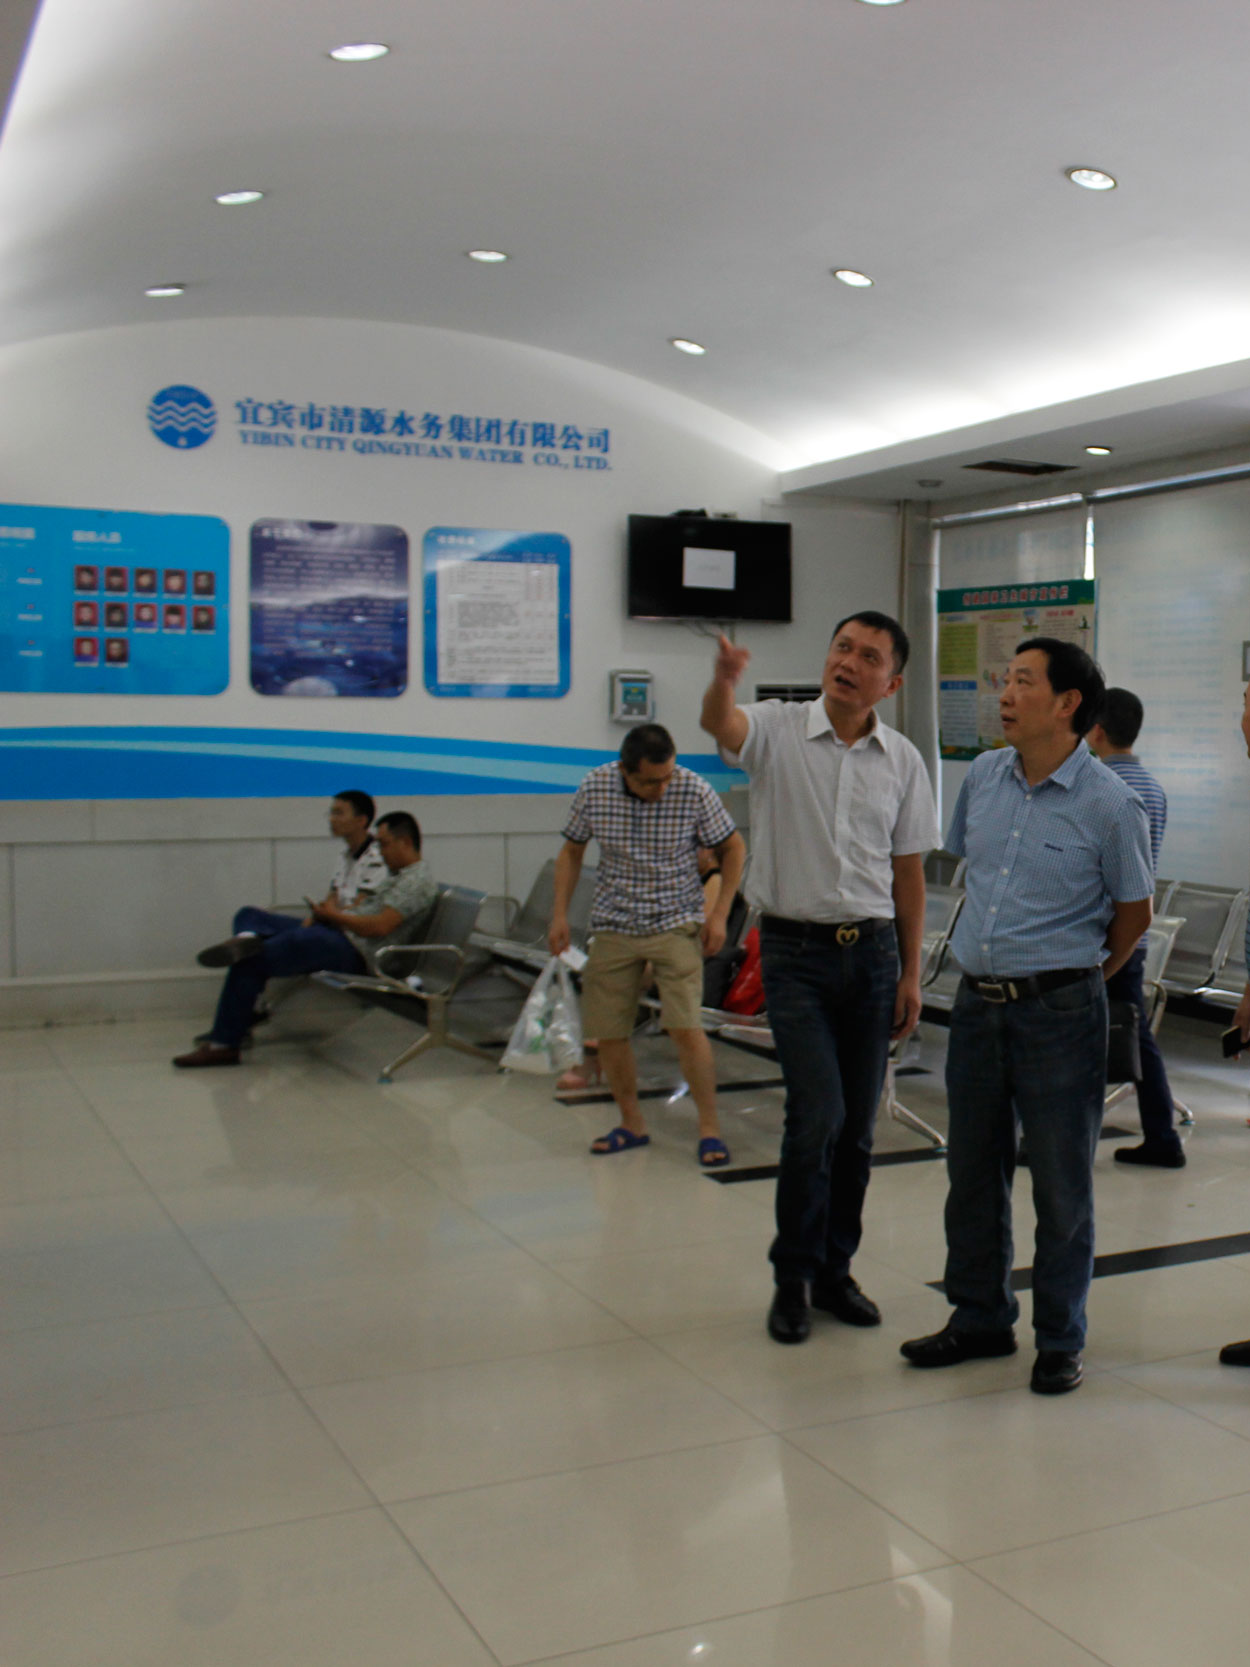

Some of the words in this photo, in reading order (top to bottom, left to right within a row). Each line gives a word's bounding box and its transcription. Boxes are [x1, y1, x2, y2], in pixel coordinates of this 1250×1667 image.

[235, 397, 610, 453] 宜宾市清源水务集团有限公司
[238, 429, 295, 447] YIBIN
[301, 434, 346, 451] CITY
[352, 438, 454, 459] QINGYUAN
[458, 446, 524, 464] WATER
